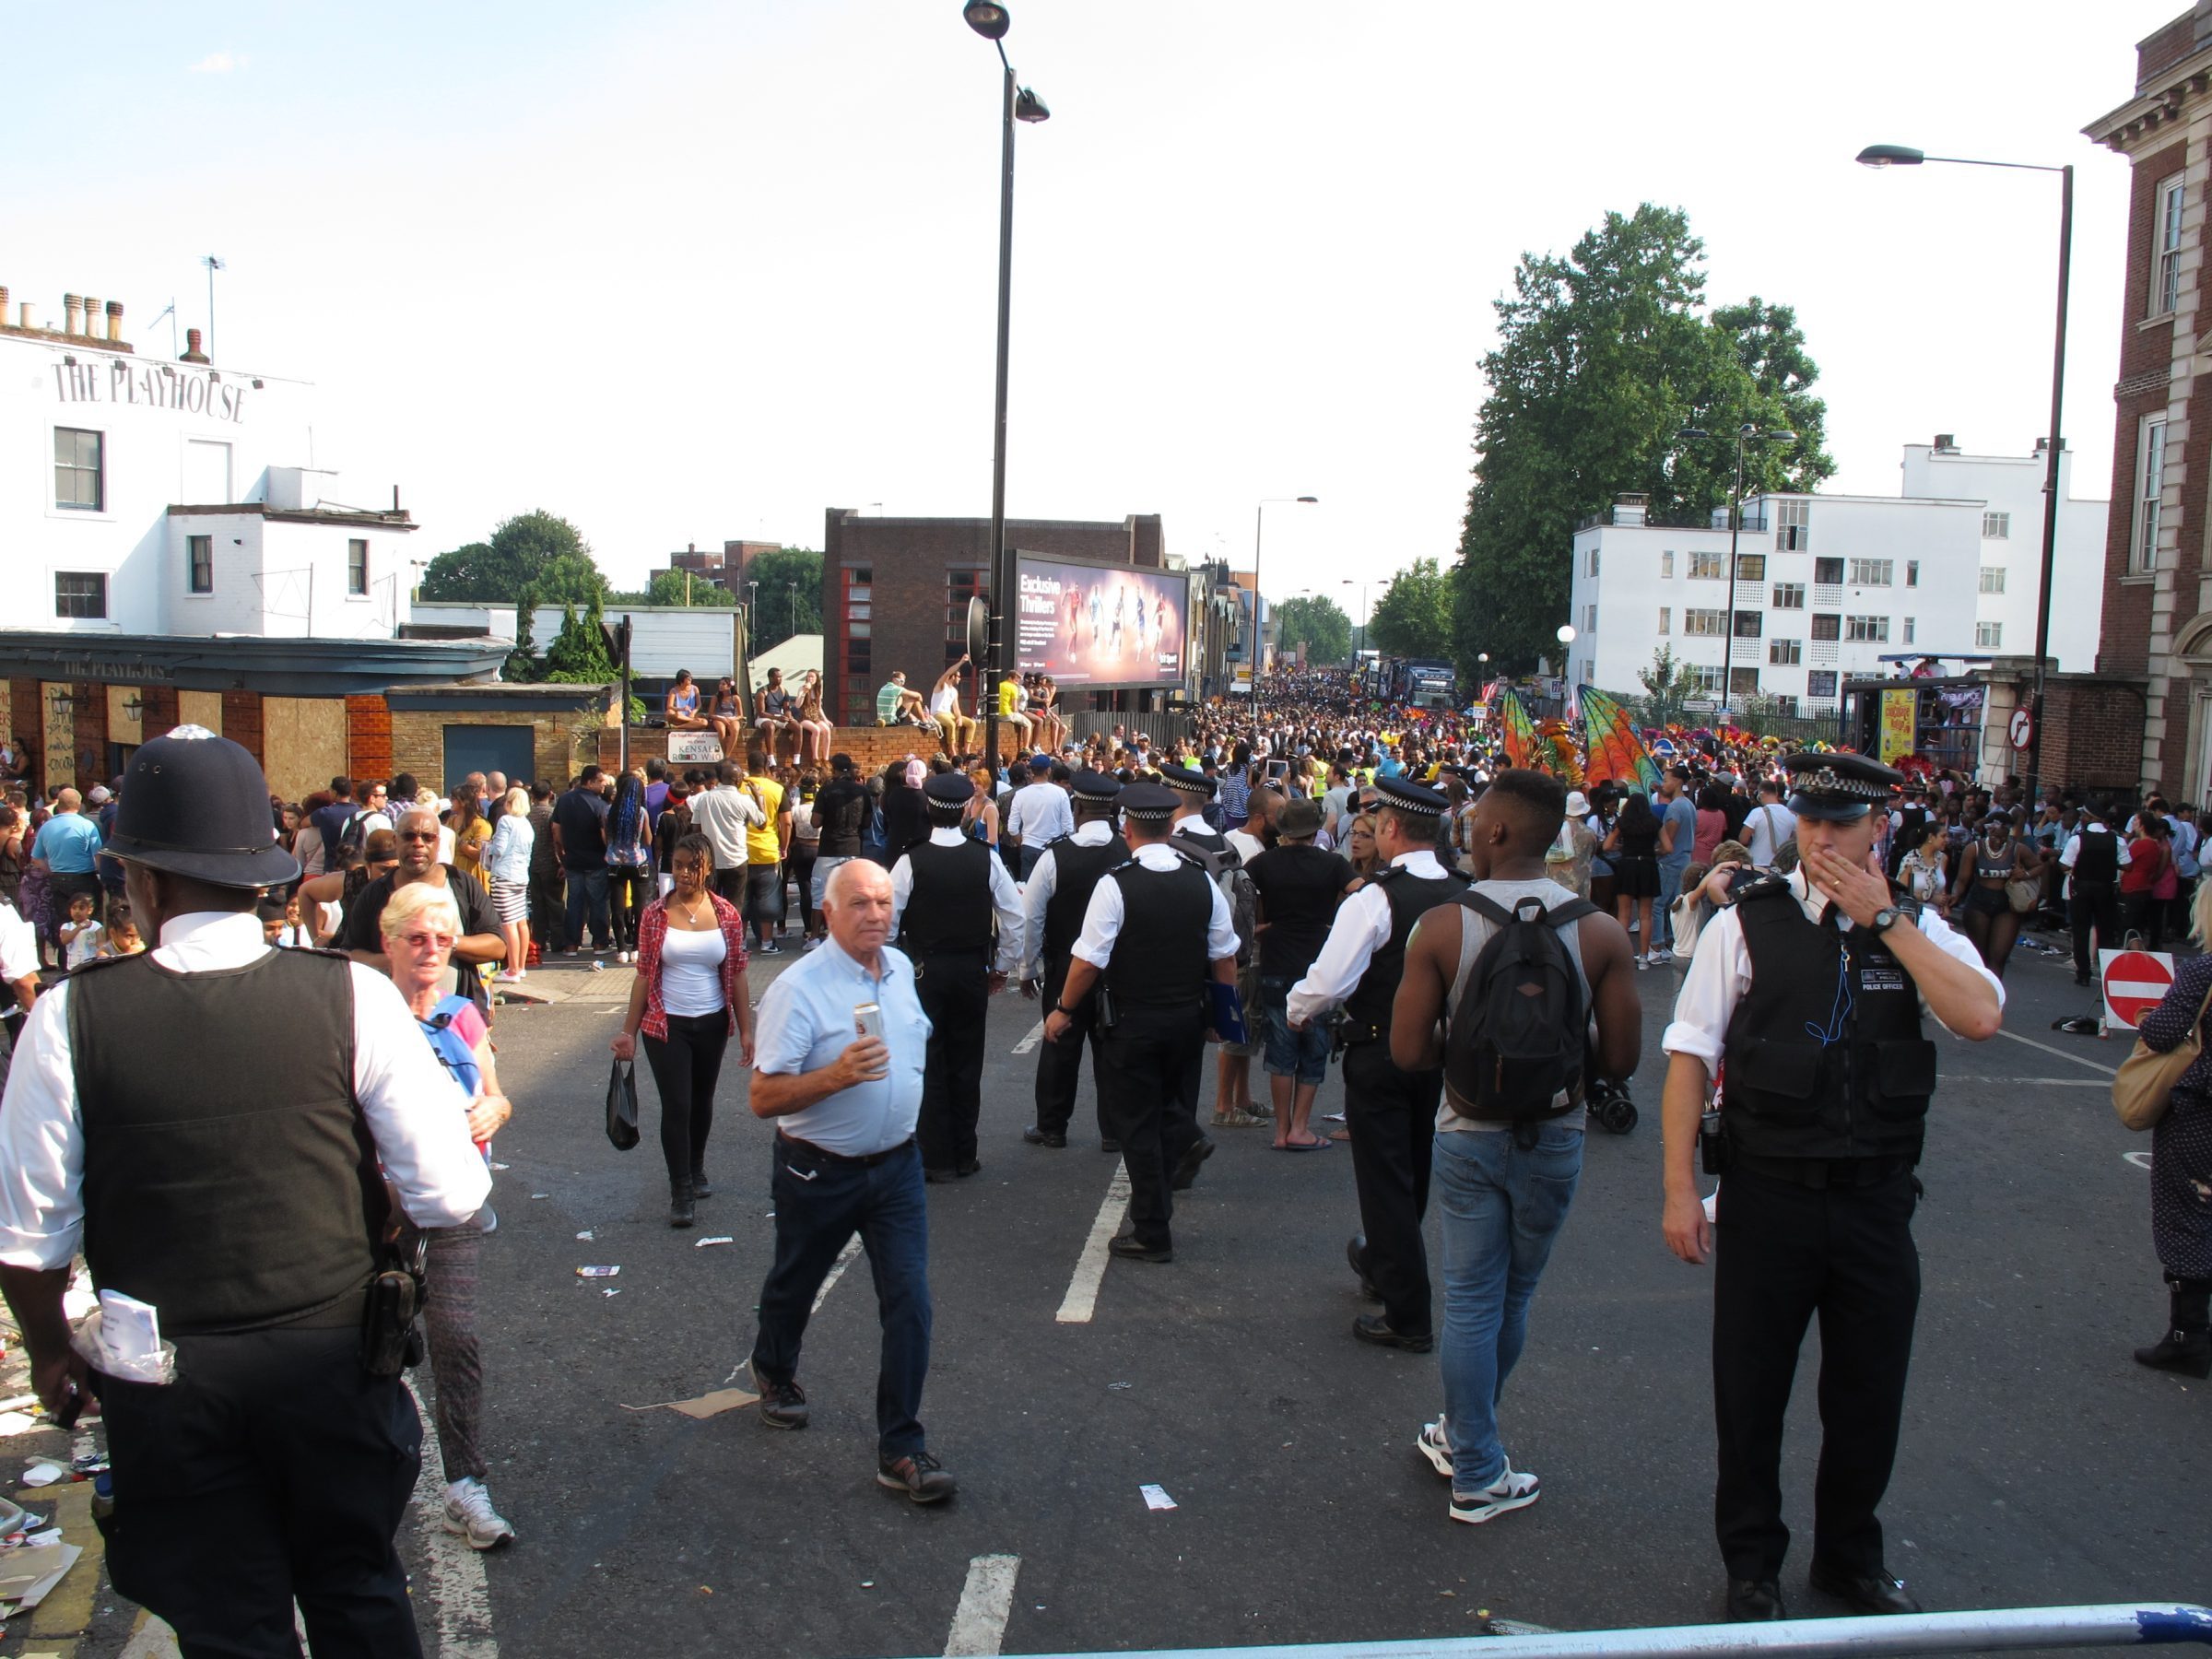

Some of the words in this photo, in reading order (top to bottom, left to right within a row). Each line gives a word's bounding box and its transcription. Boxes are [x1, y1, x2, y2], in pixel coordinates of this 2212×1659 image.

[51, 363, 101, 403] THE
[109, 364, 246, 424] PLAYHOUSE
[1020, 573, 1061, 595] Exclusive
[1019, 594, 1055, 615] Thrillers
[678, 745, 713, 753] KENSAL
